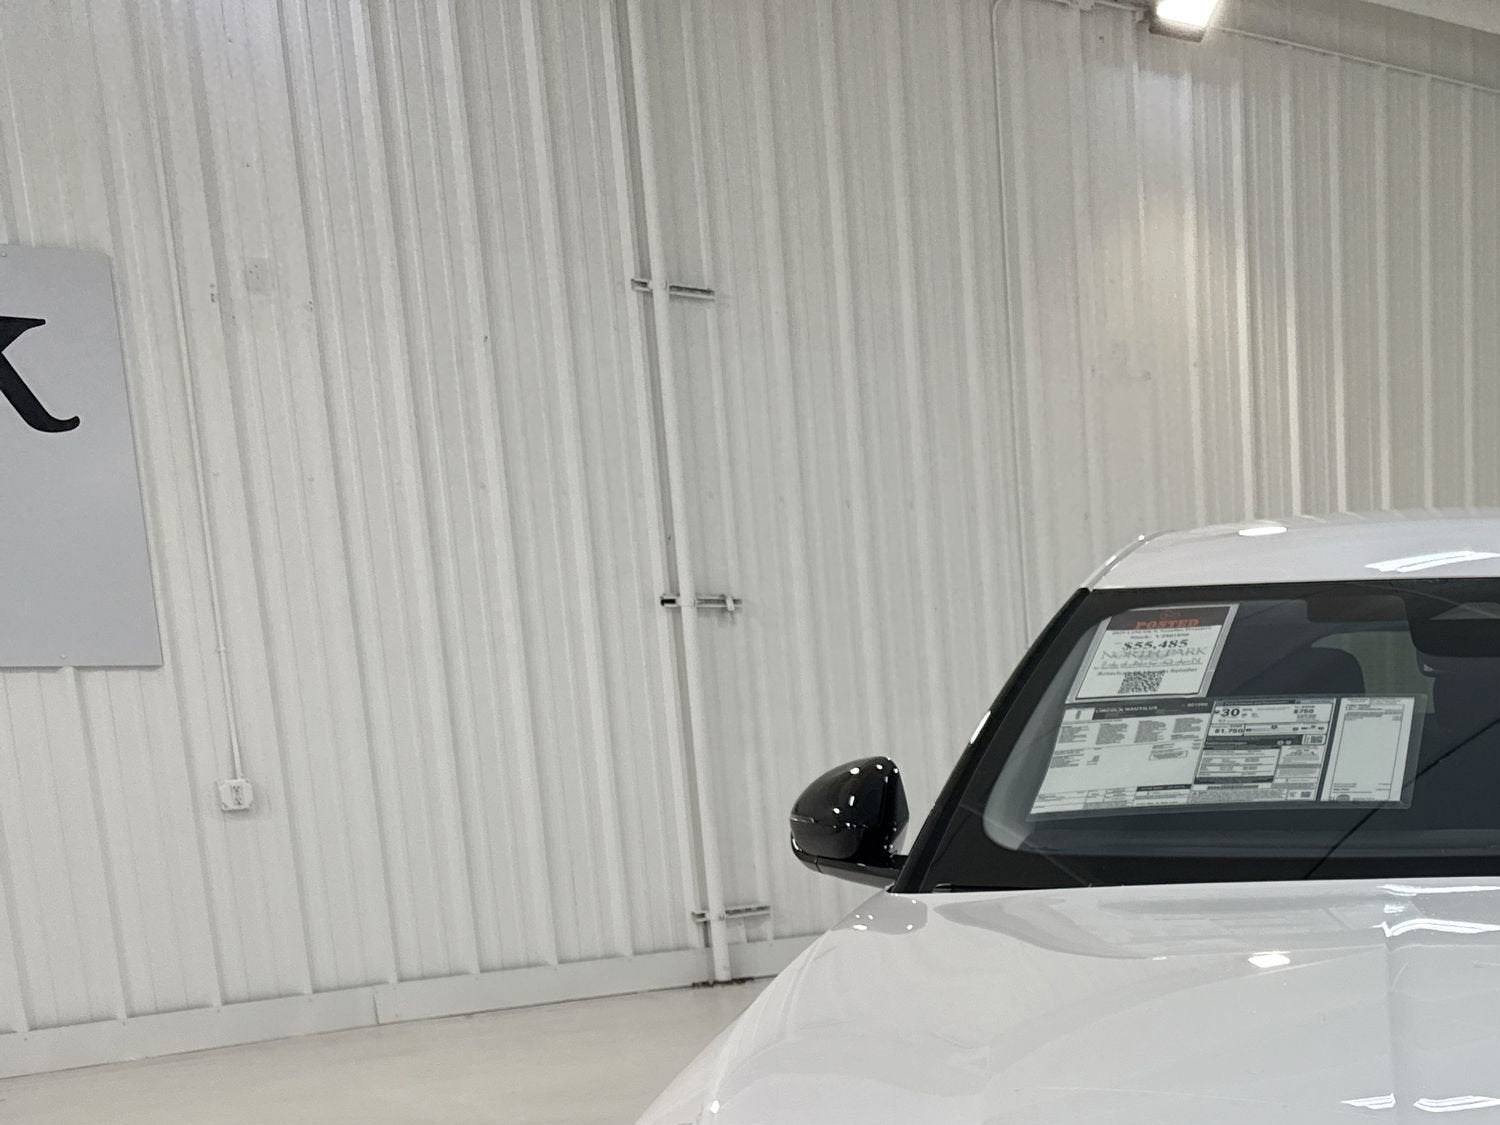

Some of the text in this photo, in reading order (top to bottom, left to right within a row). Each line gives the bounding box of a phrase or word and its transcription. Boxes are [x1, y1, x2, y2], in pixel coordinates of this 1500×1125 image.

[1136, 618, 1199, 630] POSTED
[1123, 639, 1189, 650] $55,485
[1220, 708, 1240, 717] 30
